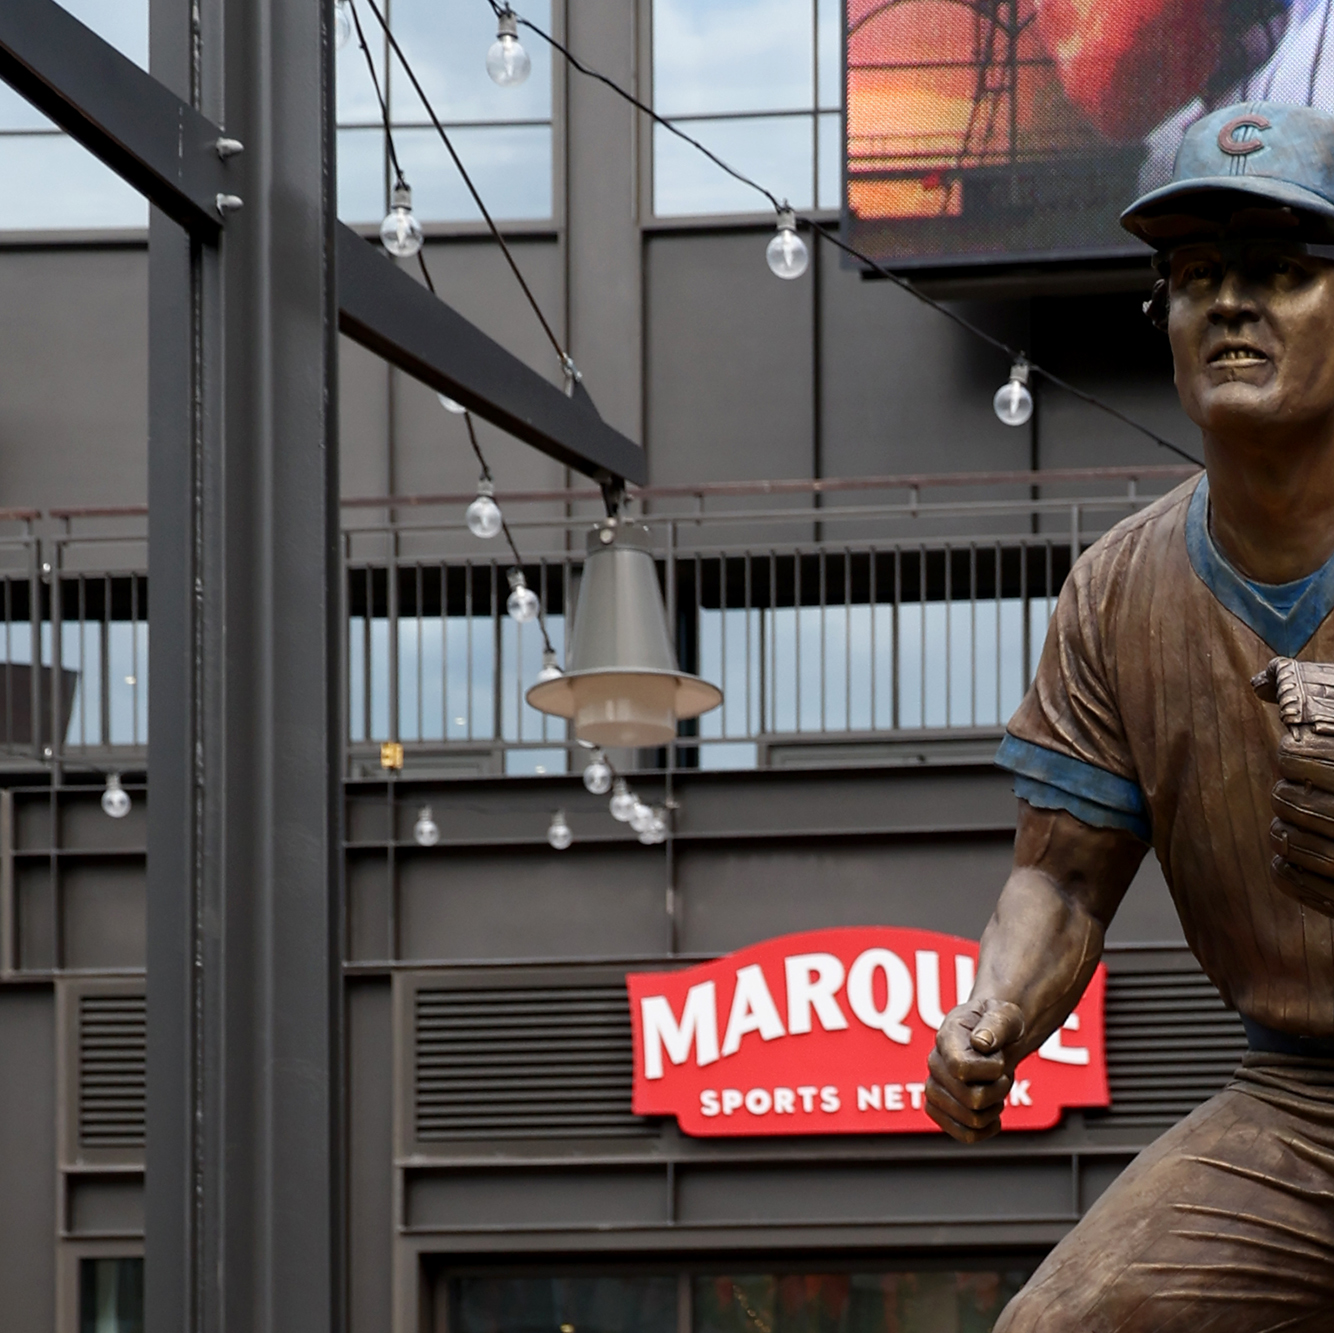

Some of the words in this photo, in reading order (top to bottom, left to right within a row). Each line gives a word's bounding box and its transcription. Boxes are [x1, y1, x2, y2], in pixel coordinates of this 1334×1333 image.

[1216, 113, 1271, 156] C
[640, 948, 1091, 1080] MARQUE
[700, 1085, 841, 1117] SPORTS
[857, 1079, 1033, 1111] NETK
